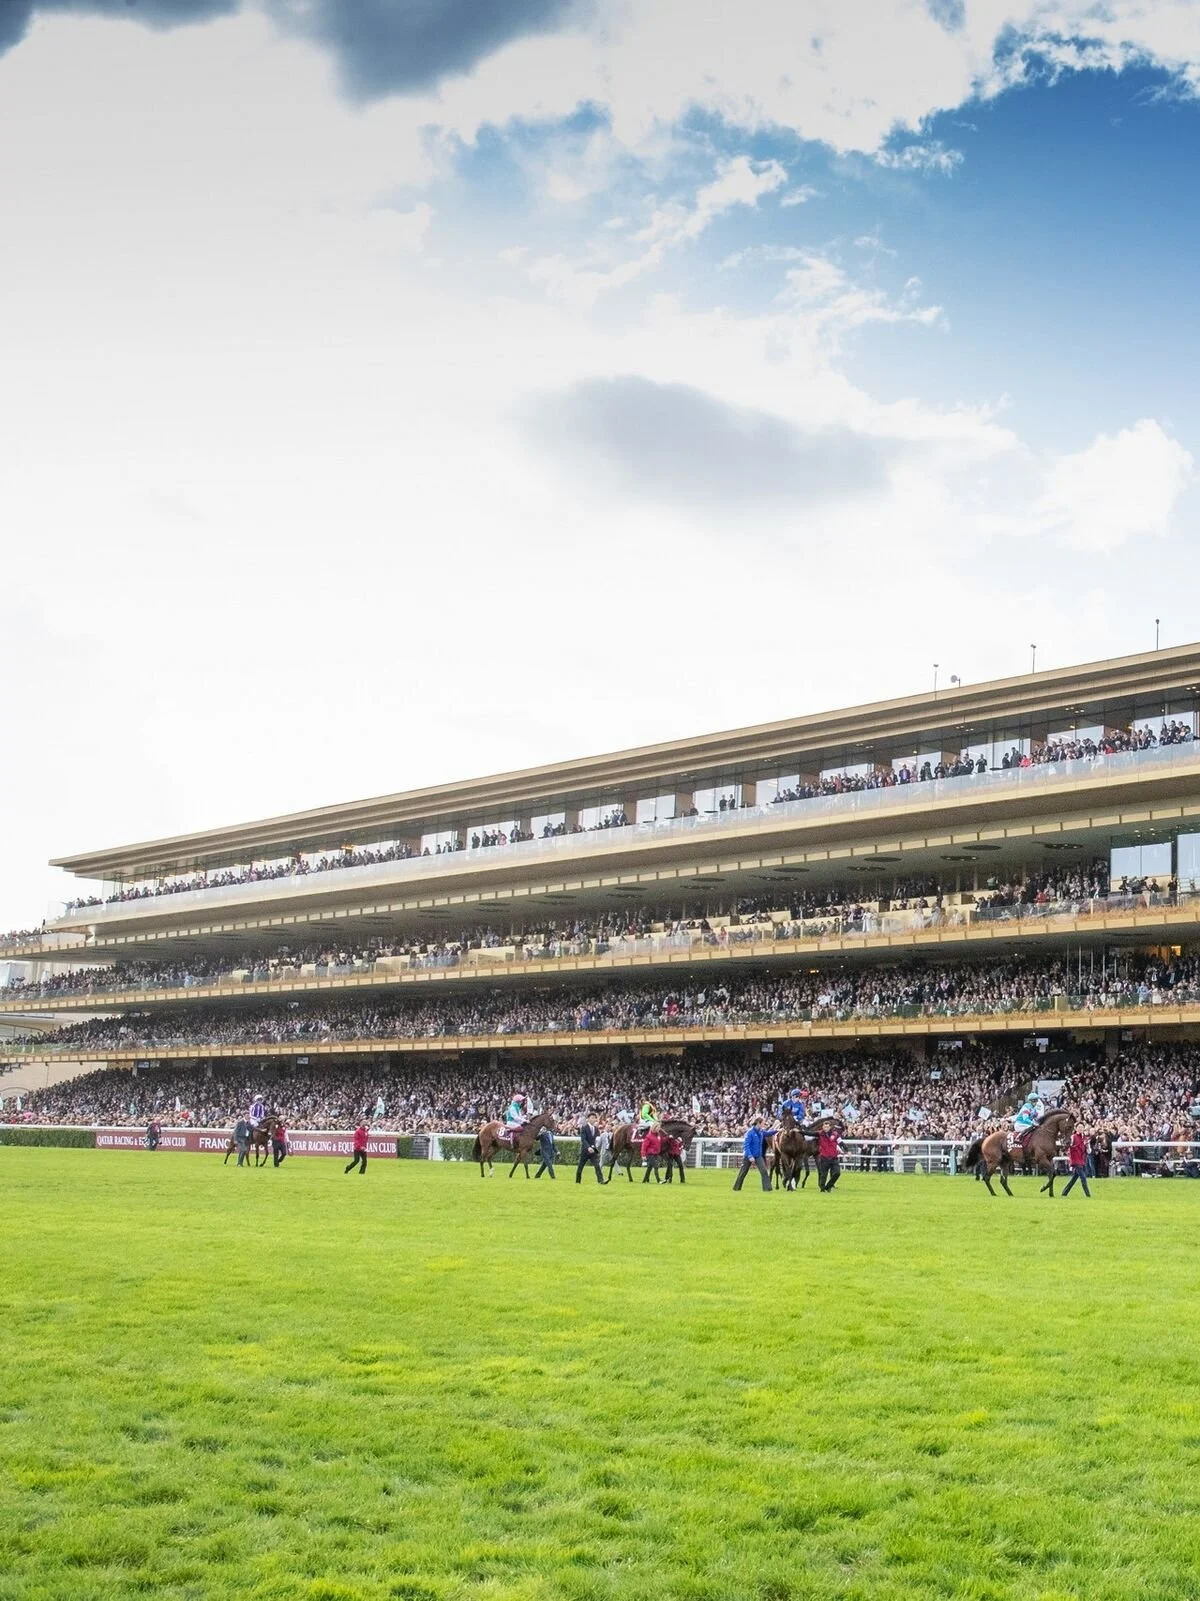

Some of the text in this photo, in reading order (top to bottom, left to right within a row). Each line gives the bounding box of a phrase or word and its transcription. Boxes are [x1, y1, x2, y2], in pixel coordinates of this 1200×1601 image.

[96, 1135, 114, 1146] QATAR
[114, 1136, 134, 1146] RACING
[171, 1137, 187, 1147] CLUB
[199, 1137, 237, 1150] FRANC
[308, 1141, 332, 1151] RACING
[332, 1143, 337, 1151] &
[378, 1142, 397, 1153] CLUB
